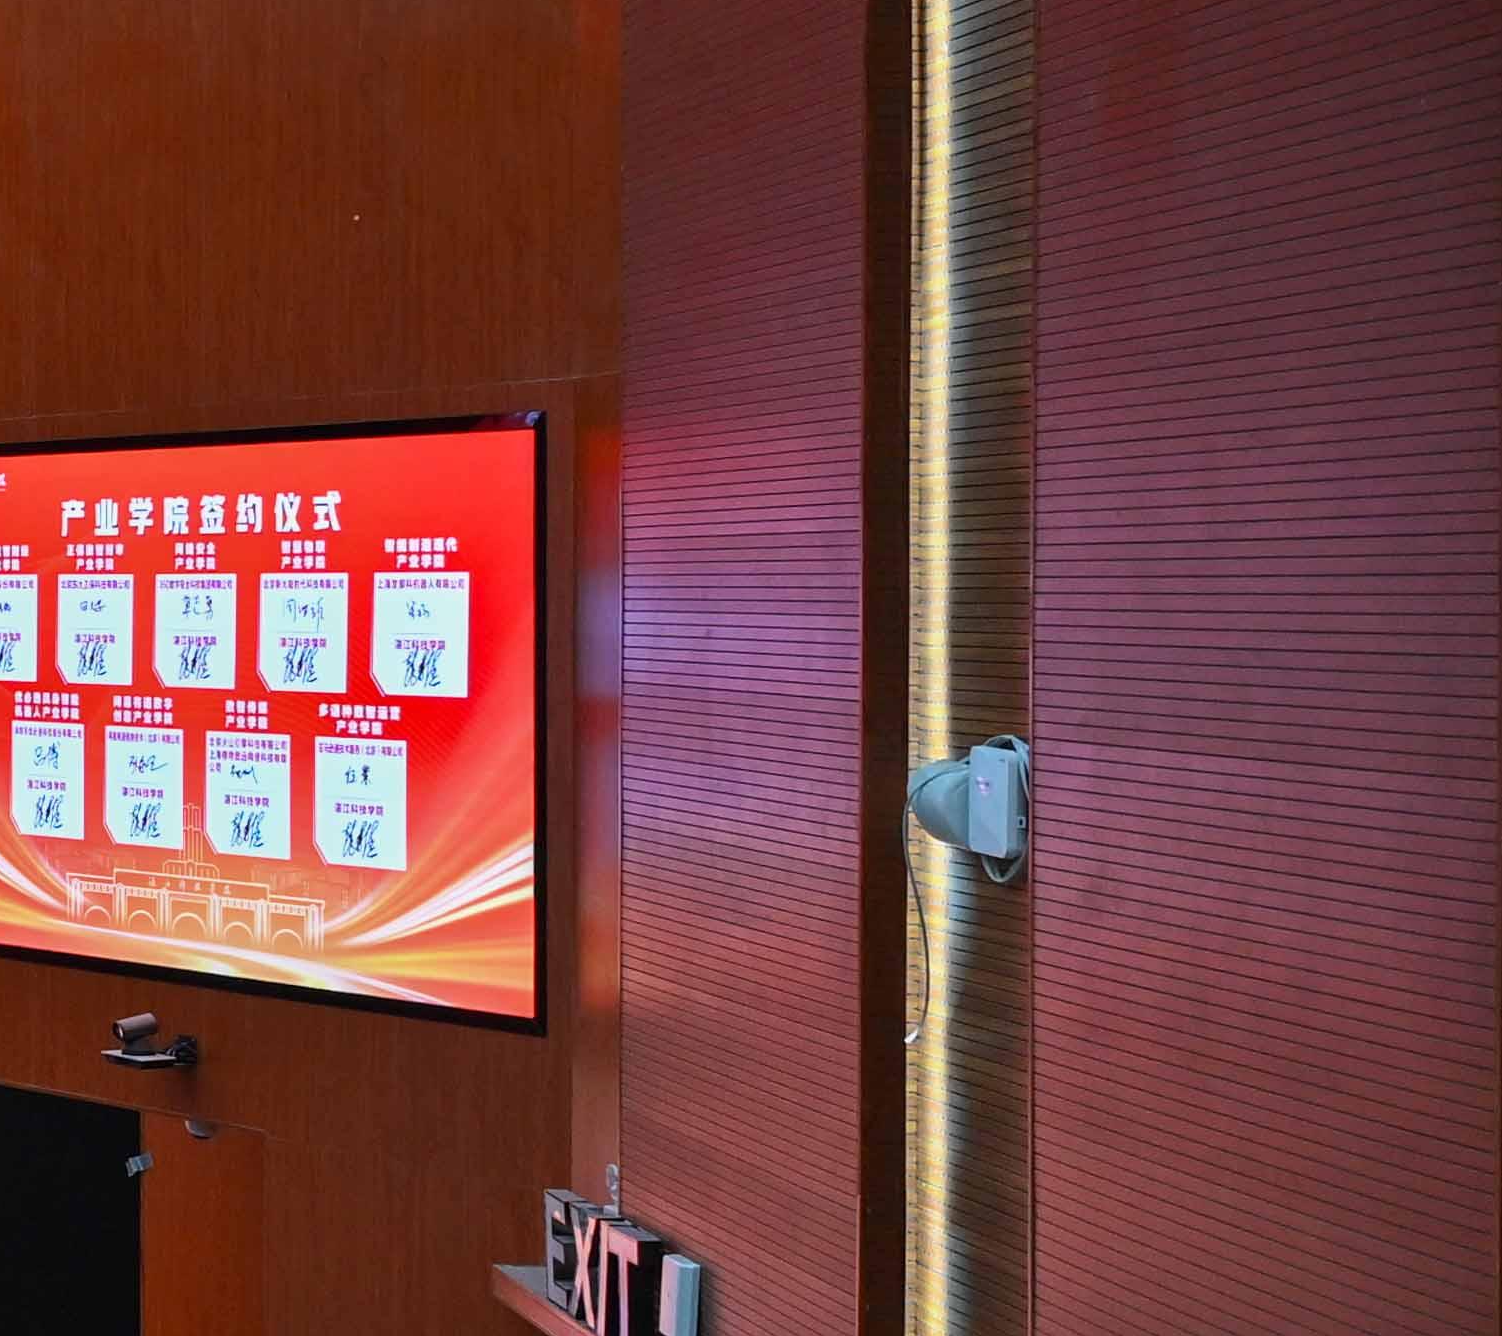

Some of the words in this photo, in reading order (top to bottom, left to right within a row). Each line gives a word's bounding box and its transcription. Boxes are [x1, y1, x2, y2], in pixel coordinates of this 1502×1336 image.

[60, 490, 342, 538] 产业学院签约仪式
